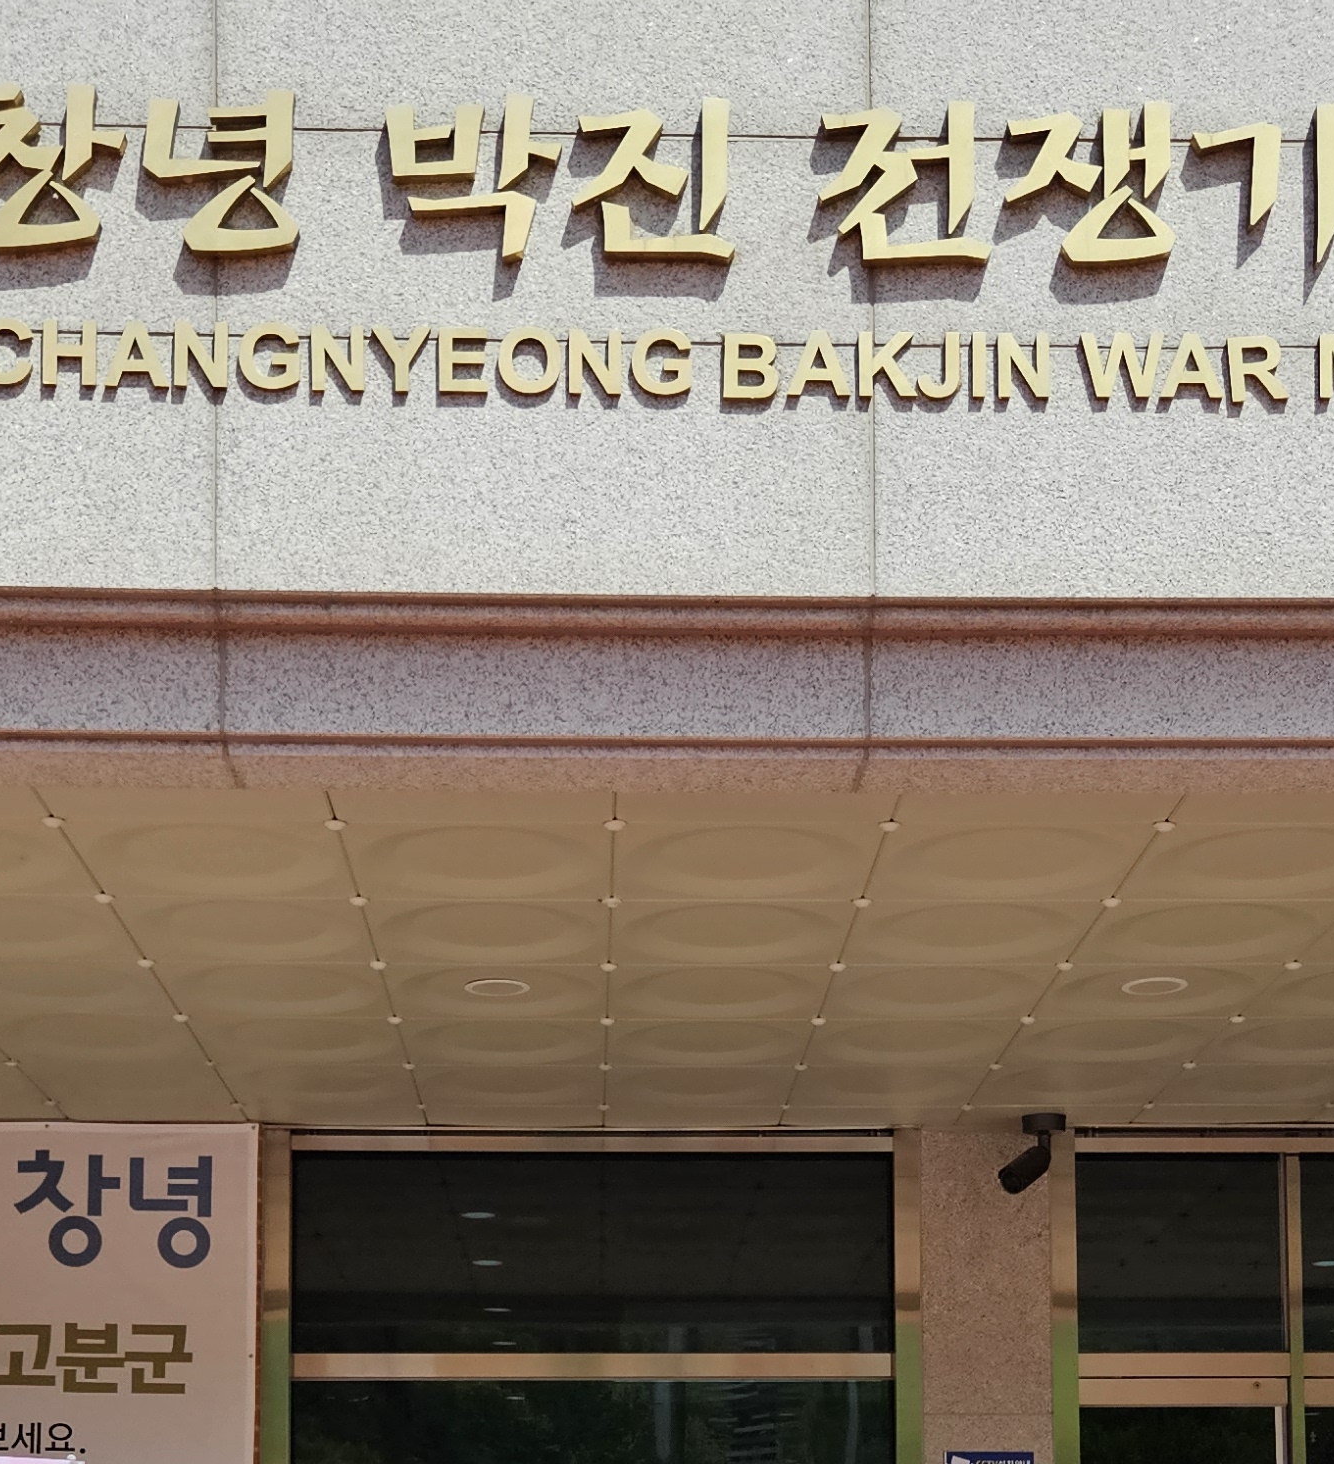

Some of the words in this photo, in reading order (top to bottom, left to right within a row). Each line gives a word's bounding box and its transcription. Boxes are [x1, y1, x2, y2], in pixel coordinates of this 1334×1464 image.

[389, 95, 735, 262] 박진
[721, 332, 1053, 402] BAKJIN
[1082, 336, 1285, 404] WAR
[13, 1148, 216, 1269] 창녕
